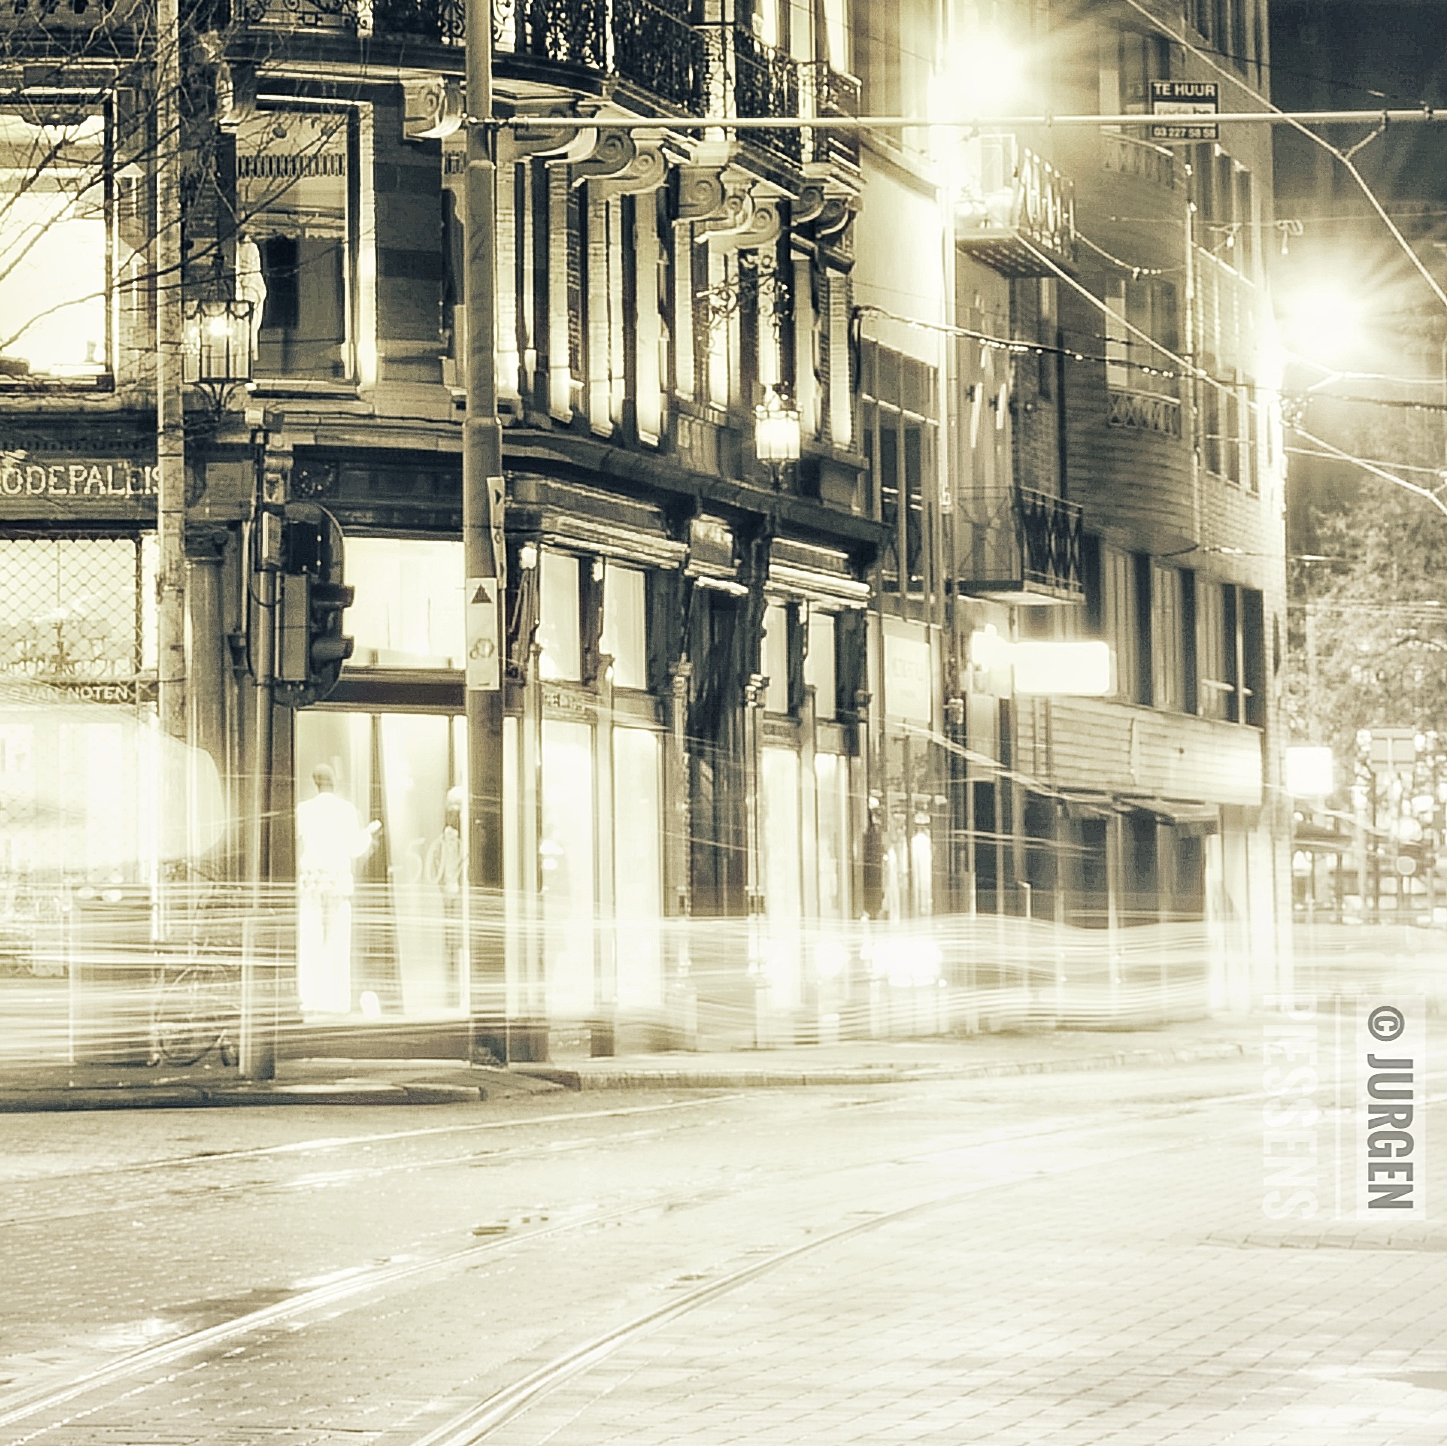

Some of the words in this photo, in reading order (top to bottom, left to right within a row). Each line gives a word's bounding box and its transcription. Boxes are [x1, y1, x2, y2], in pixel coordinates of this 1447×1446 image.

[1154, 83, 1171, 96] TE
[1174, 84, 1215, 97] HUUR
[67, 686, 130, 701] NOTEN
